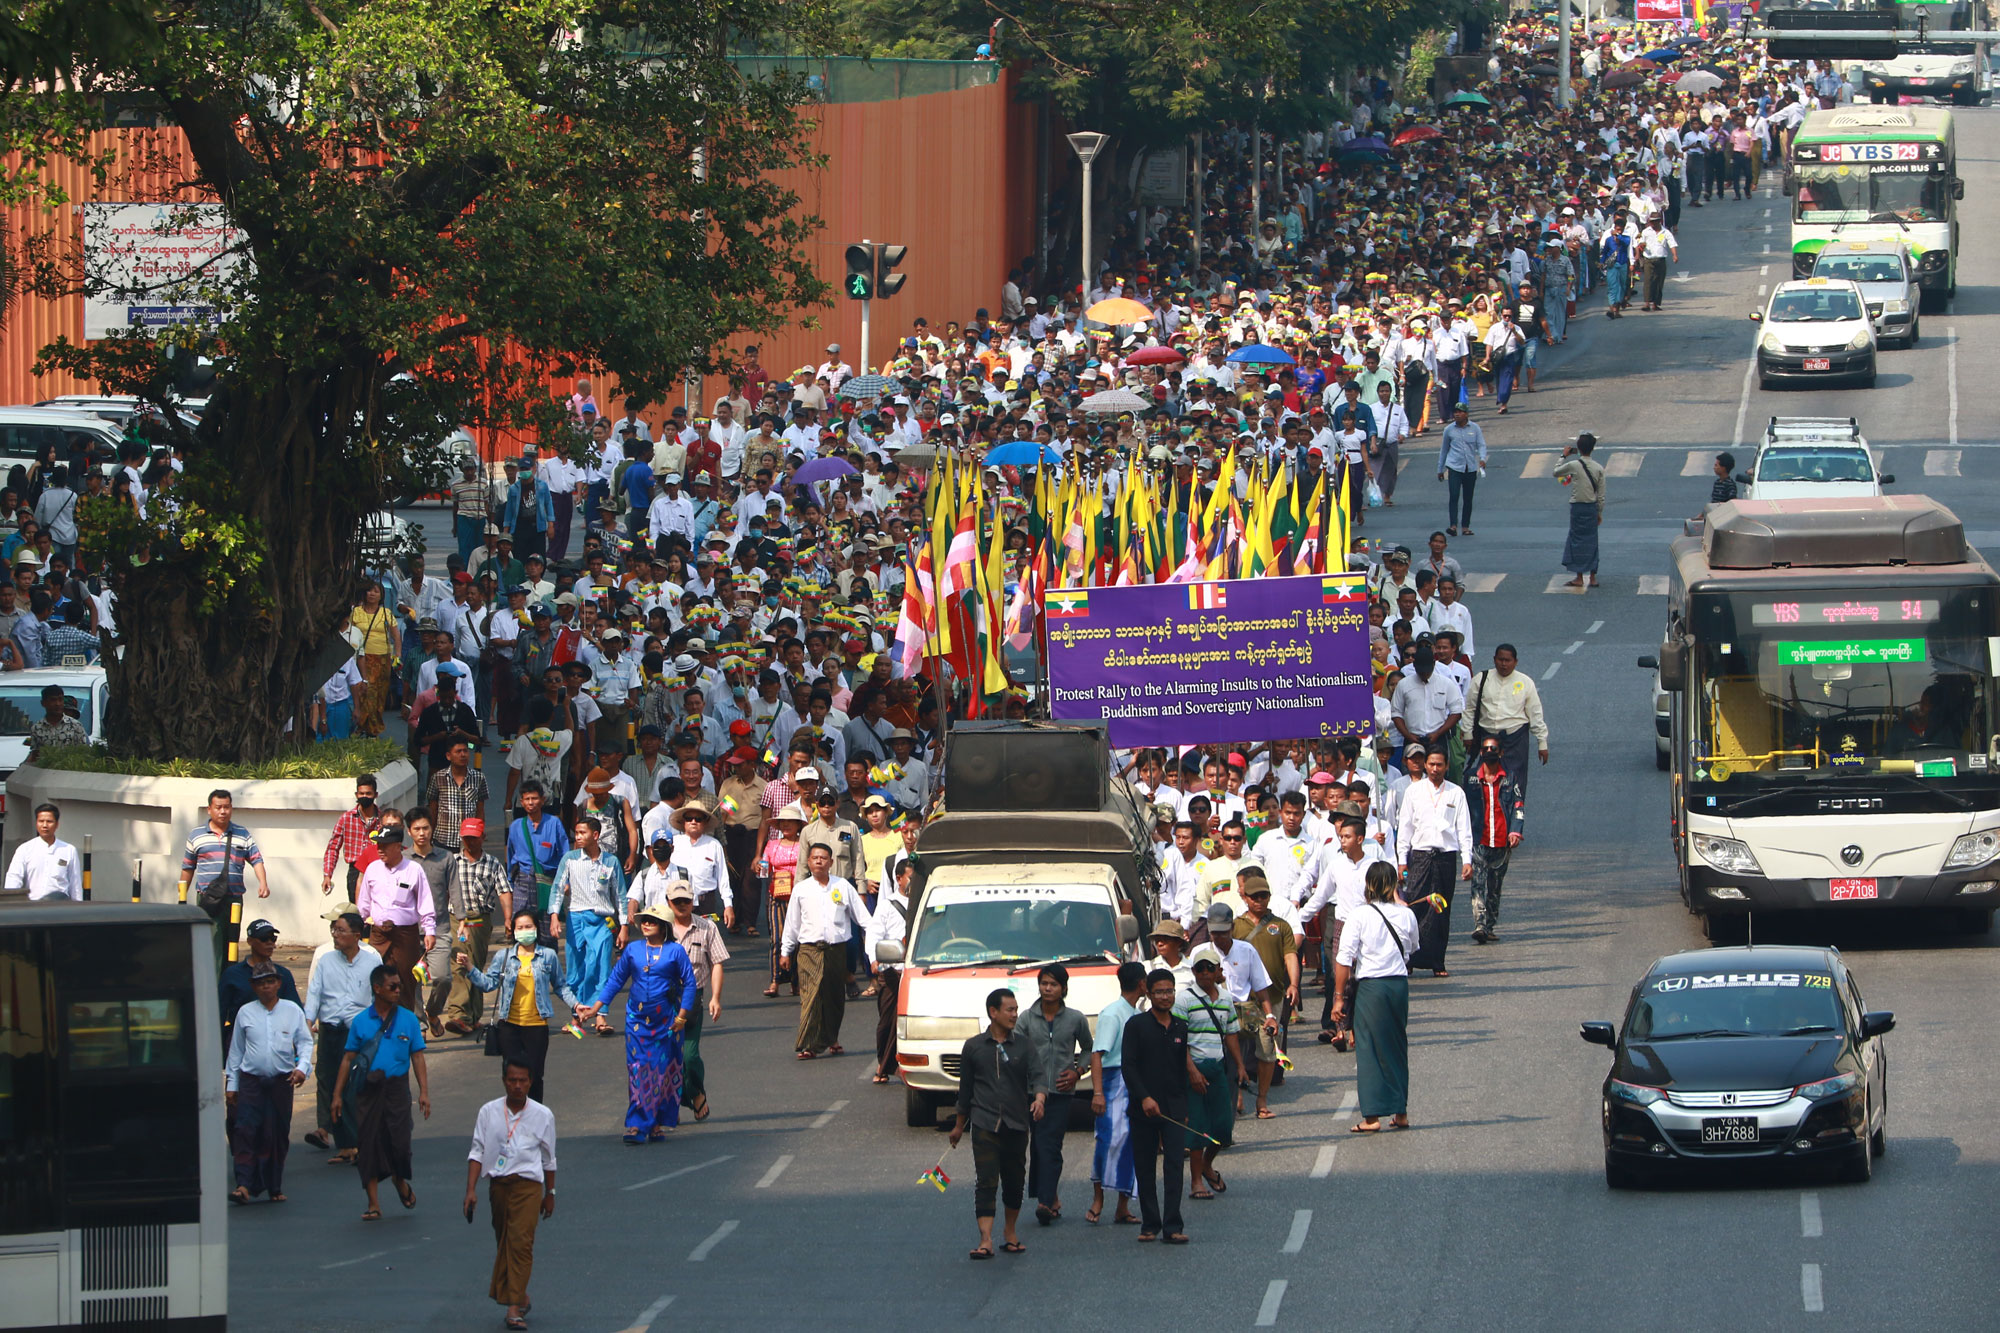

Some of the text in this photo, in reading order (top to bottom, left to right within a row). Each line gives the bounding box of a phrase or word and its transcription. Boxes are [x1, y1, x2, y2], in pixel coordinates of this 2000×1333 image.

[1849, 146, 1893, 160] YBS
[1899, 145, 1919, 160] 29
[1870, 164, 1930, 174] AIR-CON BUS
[1773, 602, 1800, 623] YBS
[1055, 672, 1368, 701] Protest Rally to the Alarming Insults to the Nationalism,
[1101, 694, 1324, 719] Buddhism and Sovereignty Nationalism
[1818, 798, 1883, 810] FOTON
[1832, 885, 1875, 898] 2P-7108
[1804, 975, 1832, 987] 729
[1721, 1118, 1739, 1126] YGN
[1705, 1126, 1755, 1141] 3H-7688
